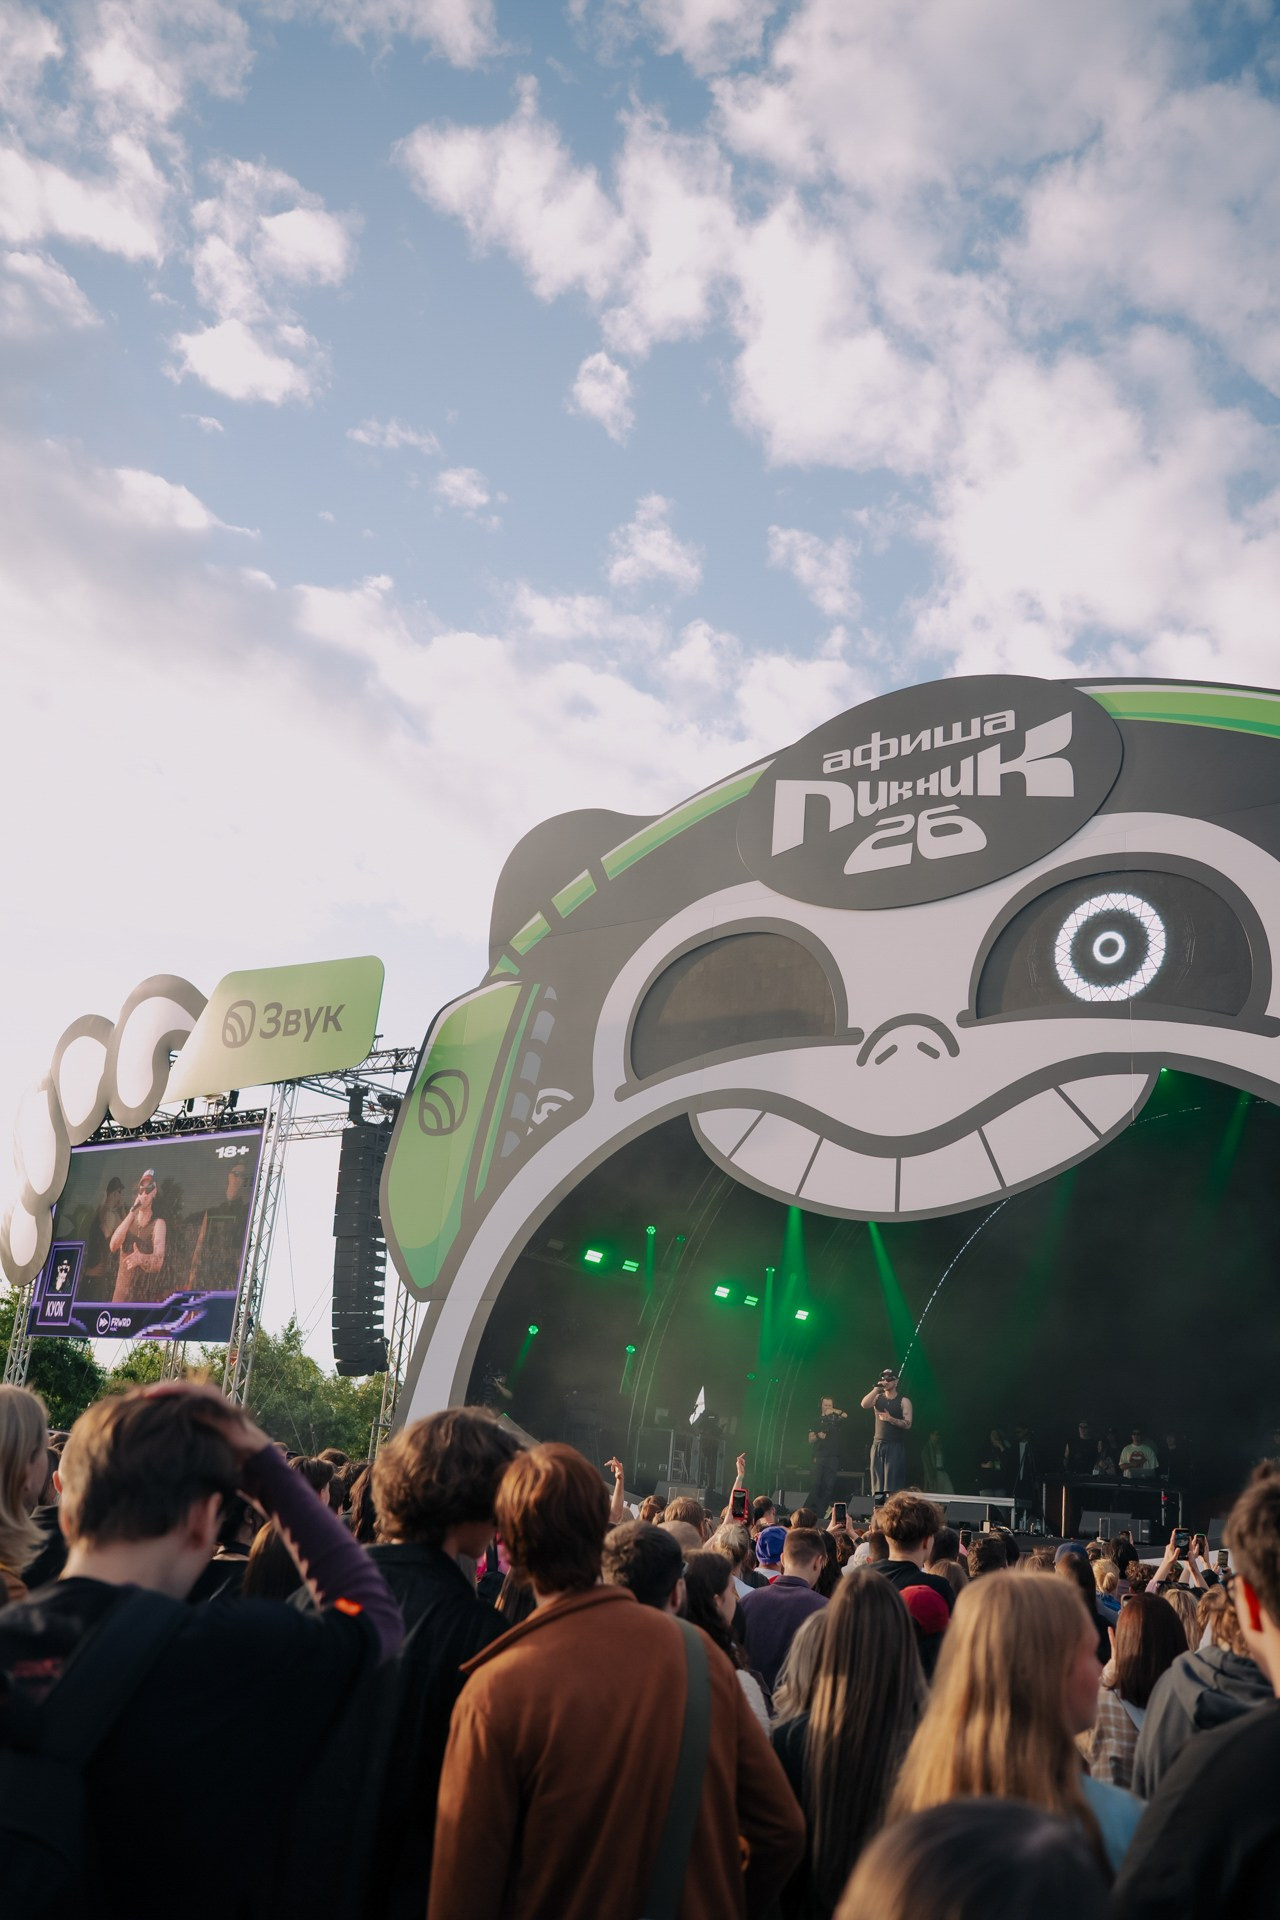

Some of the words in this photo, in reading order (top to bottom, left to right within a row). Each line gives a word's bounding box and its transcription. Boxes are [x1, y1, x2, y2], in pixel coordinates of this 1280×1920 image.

[822, 709, 1015, 774] афиша
[843, 804, 988, 875] 26
[259, 1001, 346, 1042] Звук
[215, 1145, 250, 1159] 18+
